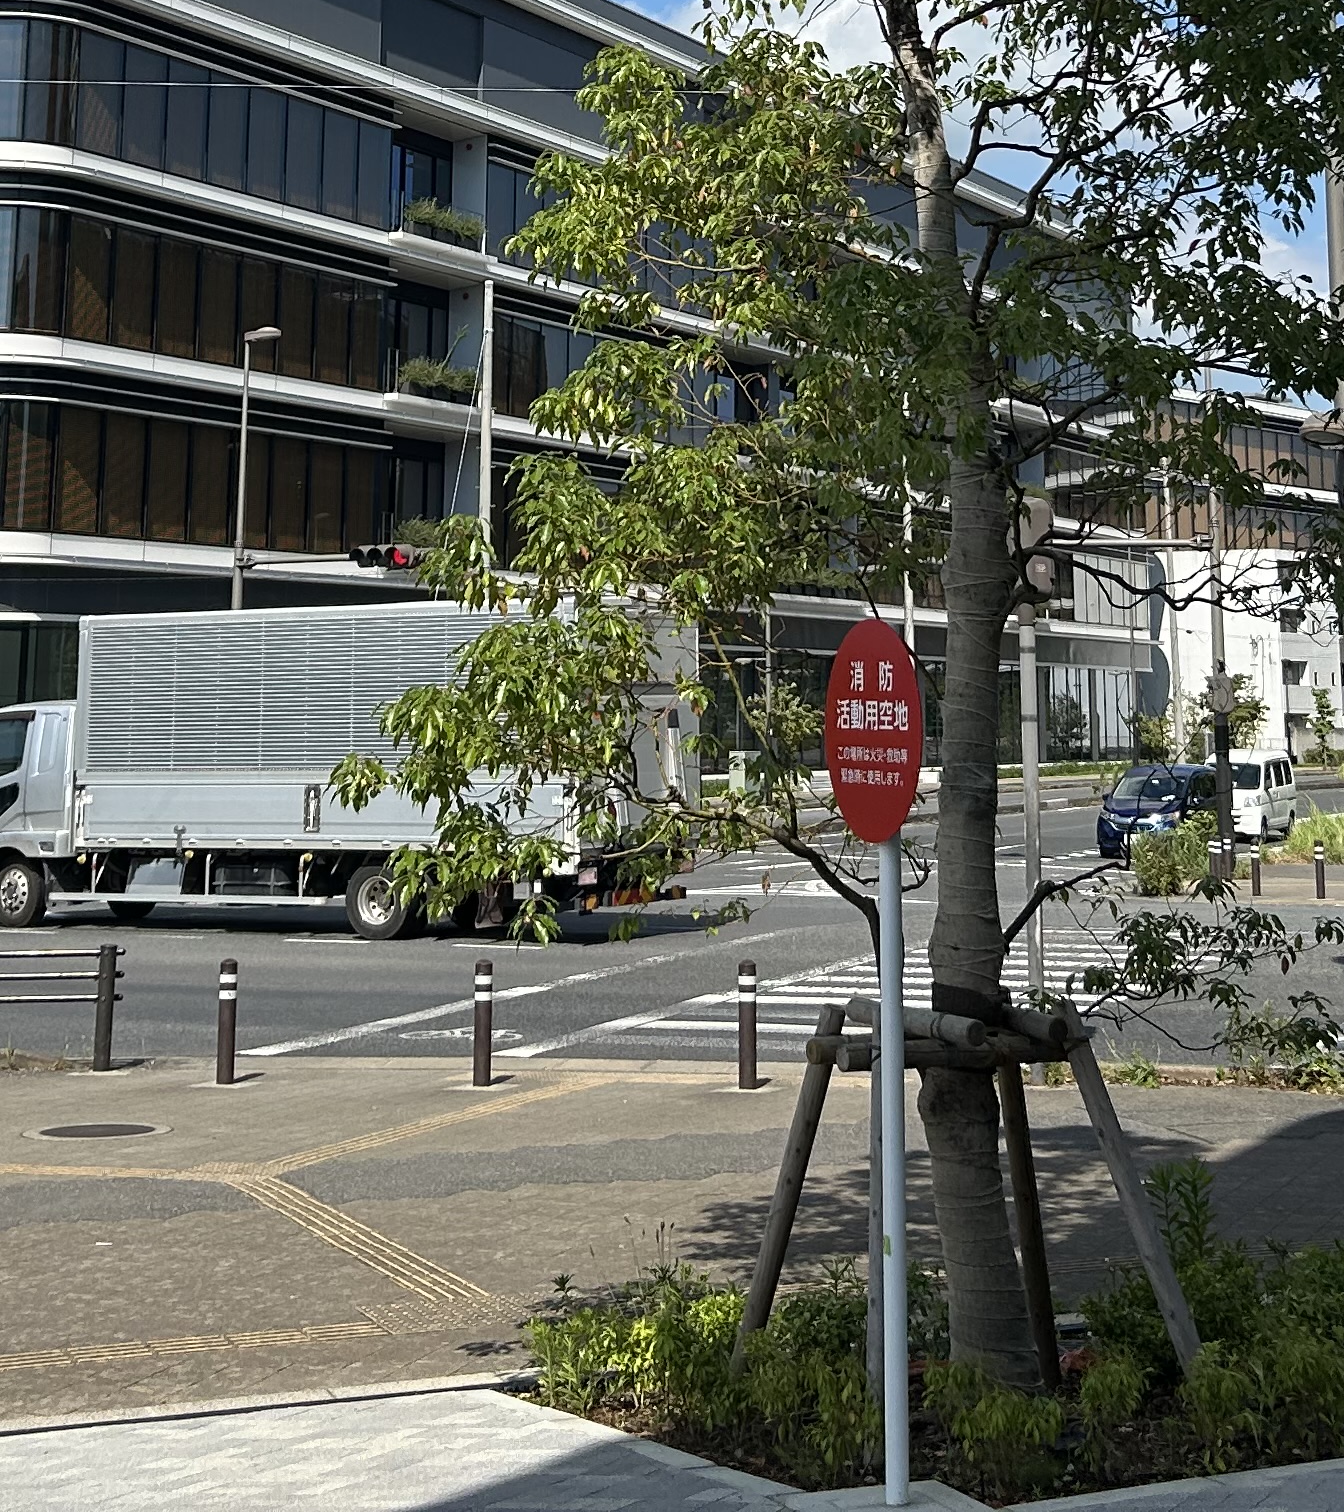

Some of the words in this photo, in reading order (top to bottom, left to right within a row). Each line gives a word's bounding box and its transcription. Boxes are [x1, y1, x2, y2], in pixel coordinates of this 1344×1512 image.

[836, 699, 909, 731] 活動用空地
